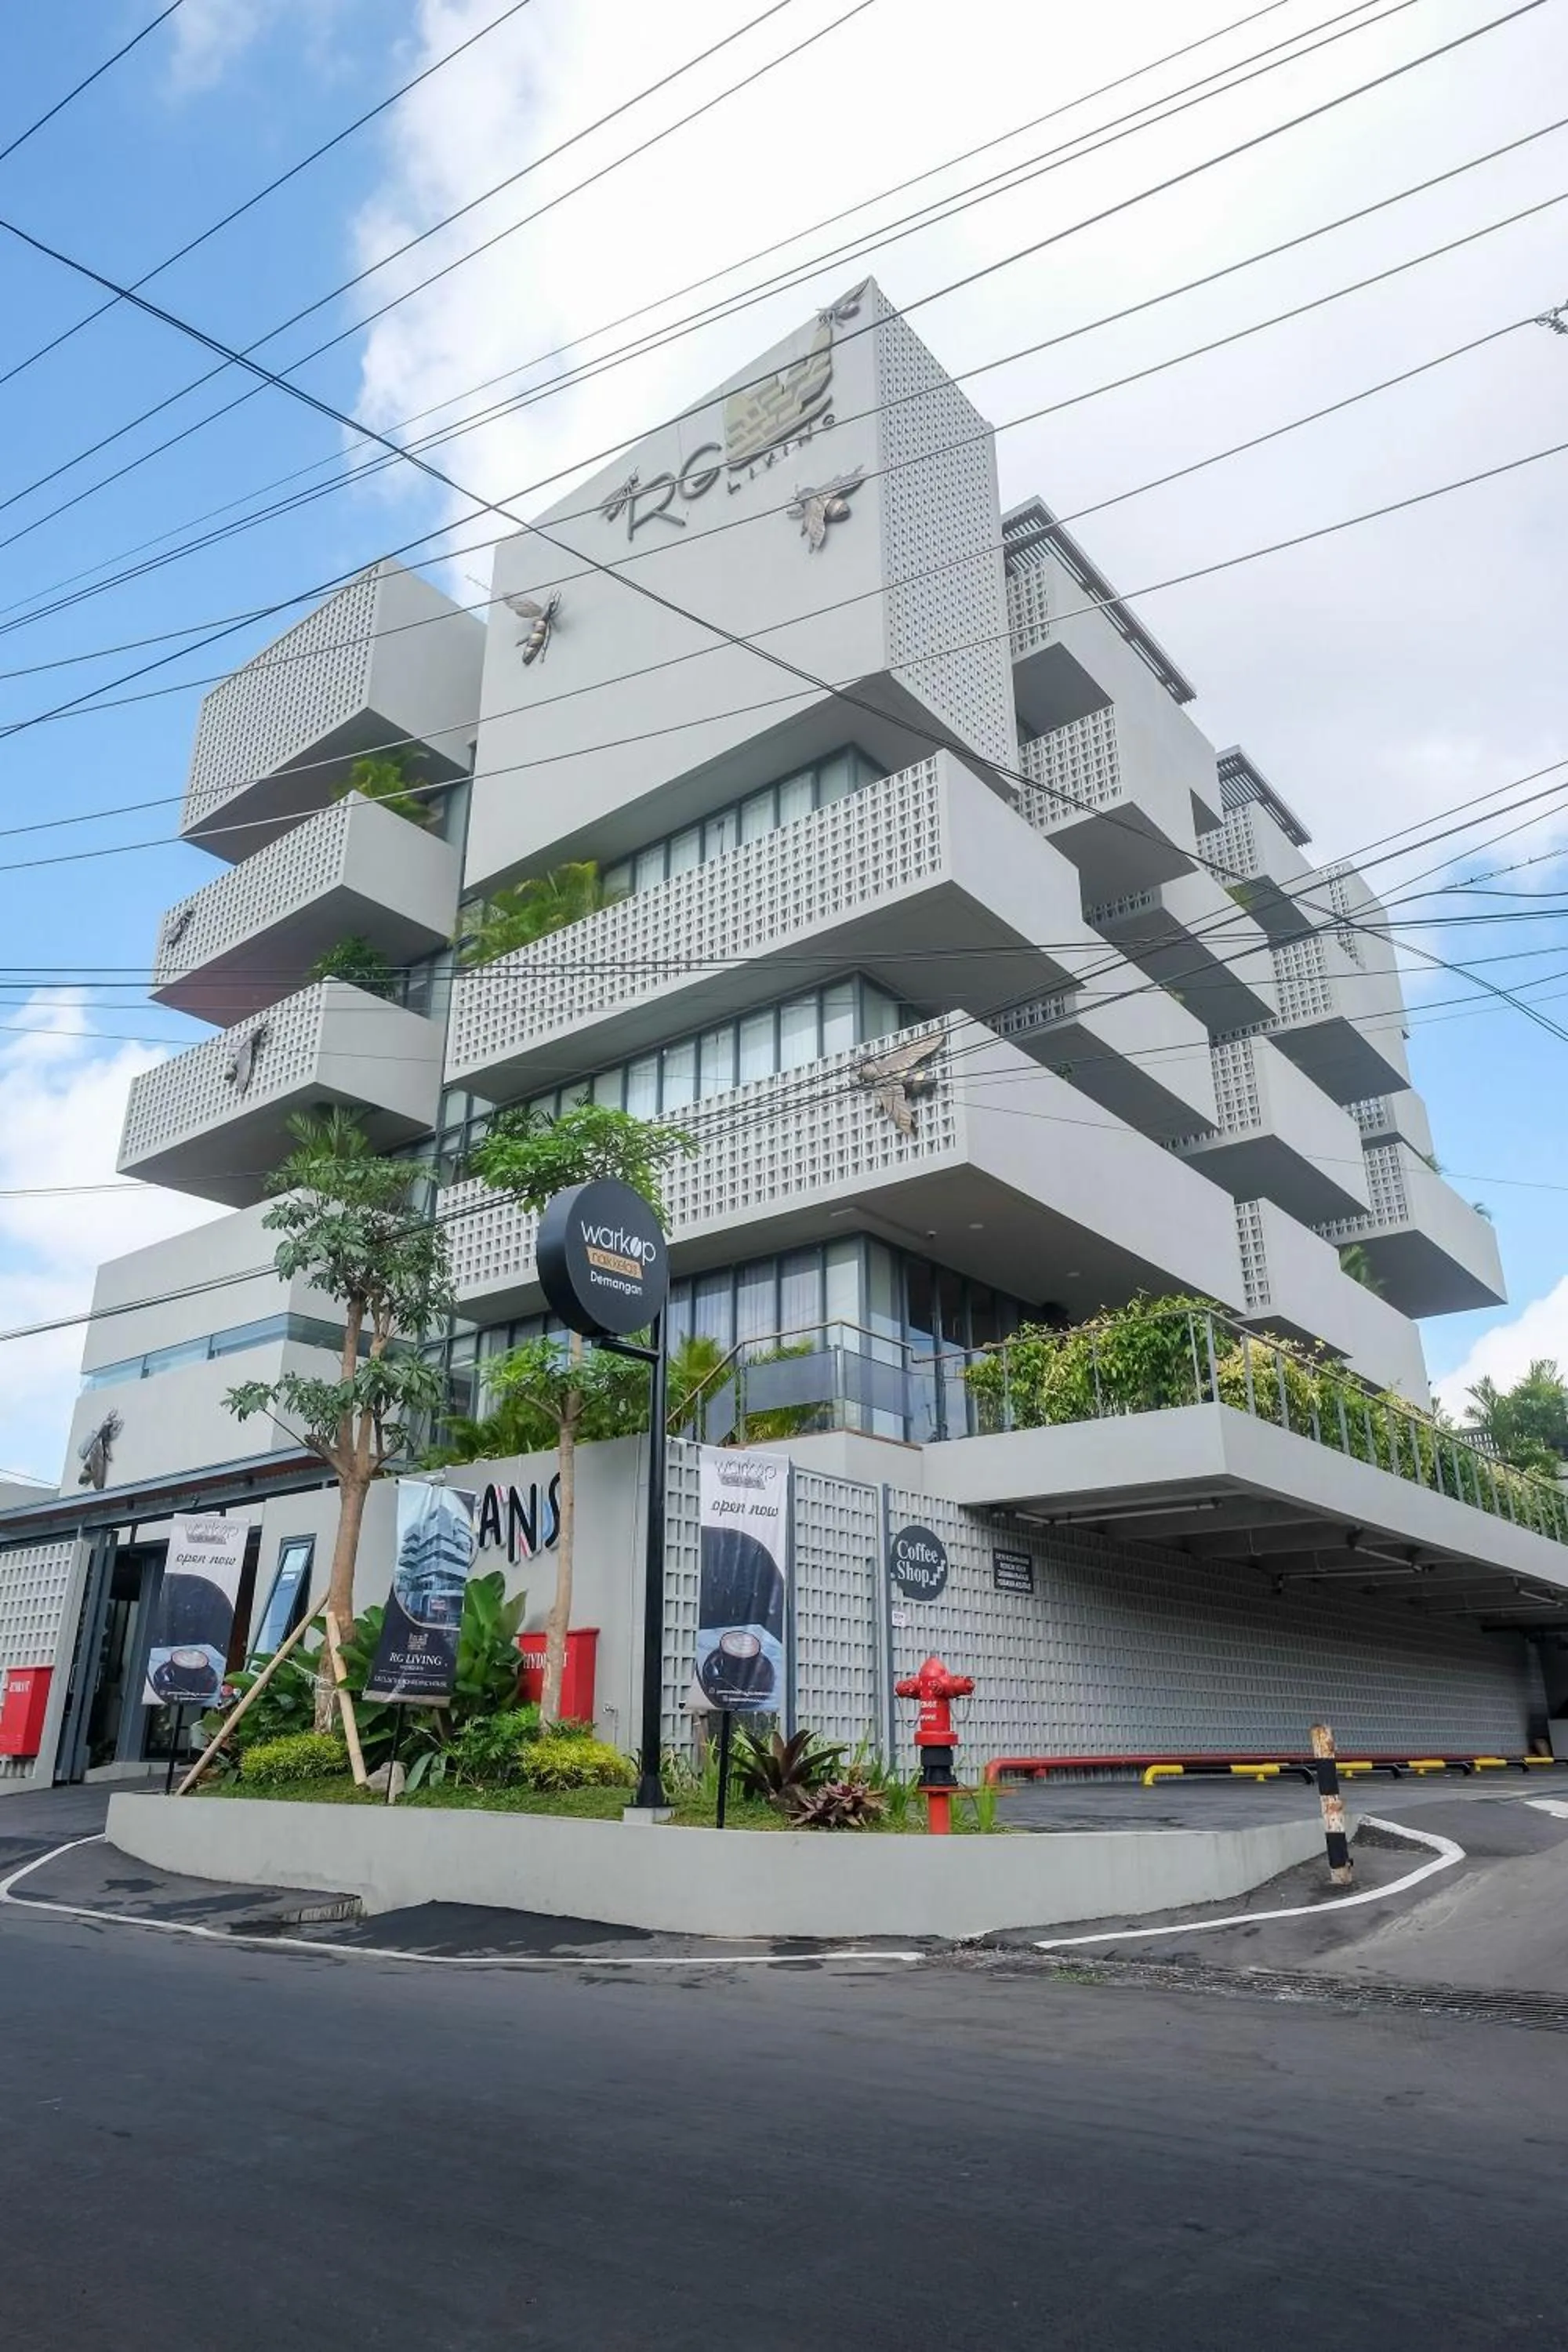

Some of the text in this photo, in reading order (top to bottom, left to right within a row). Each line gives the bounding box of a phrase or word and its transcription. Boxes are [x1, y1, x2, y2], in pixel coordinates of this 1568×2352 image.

[580, 1220, 656, 1265] warkop
[590, 1270, 643, 1297] Demangan
[470, 1472, 561, 1563] ANS
[711, 1500, 779, 1517] open now
[176, 1553, 237, 1566] open now
[897, 1540, 938, 1563] Coffee
[896, 1560, 931, 1588] Shop
[390, 1652, 443, 1666] RG LIVING
